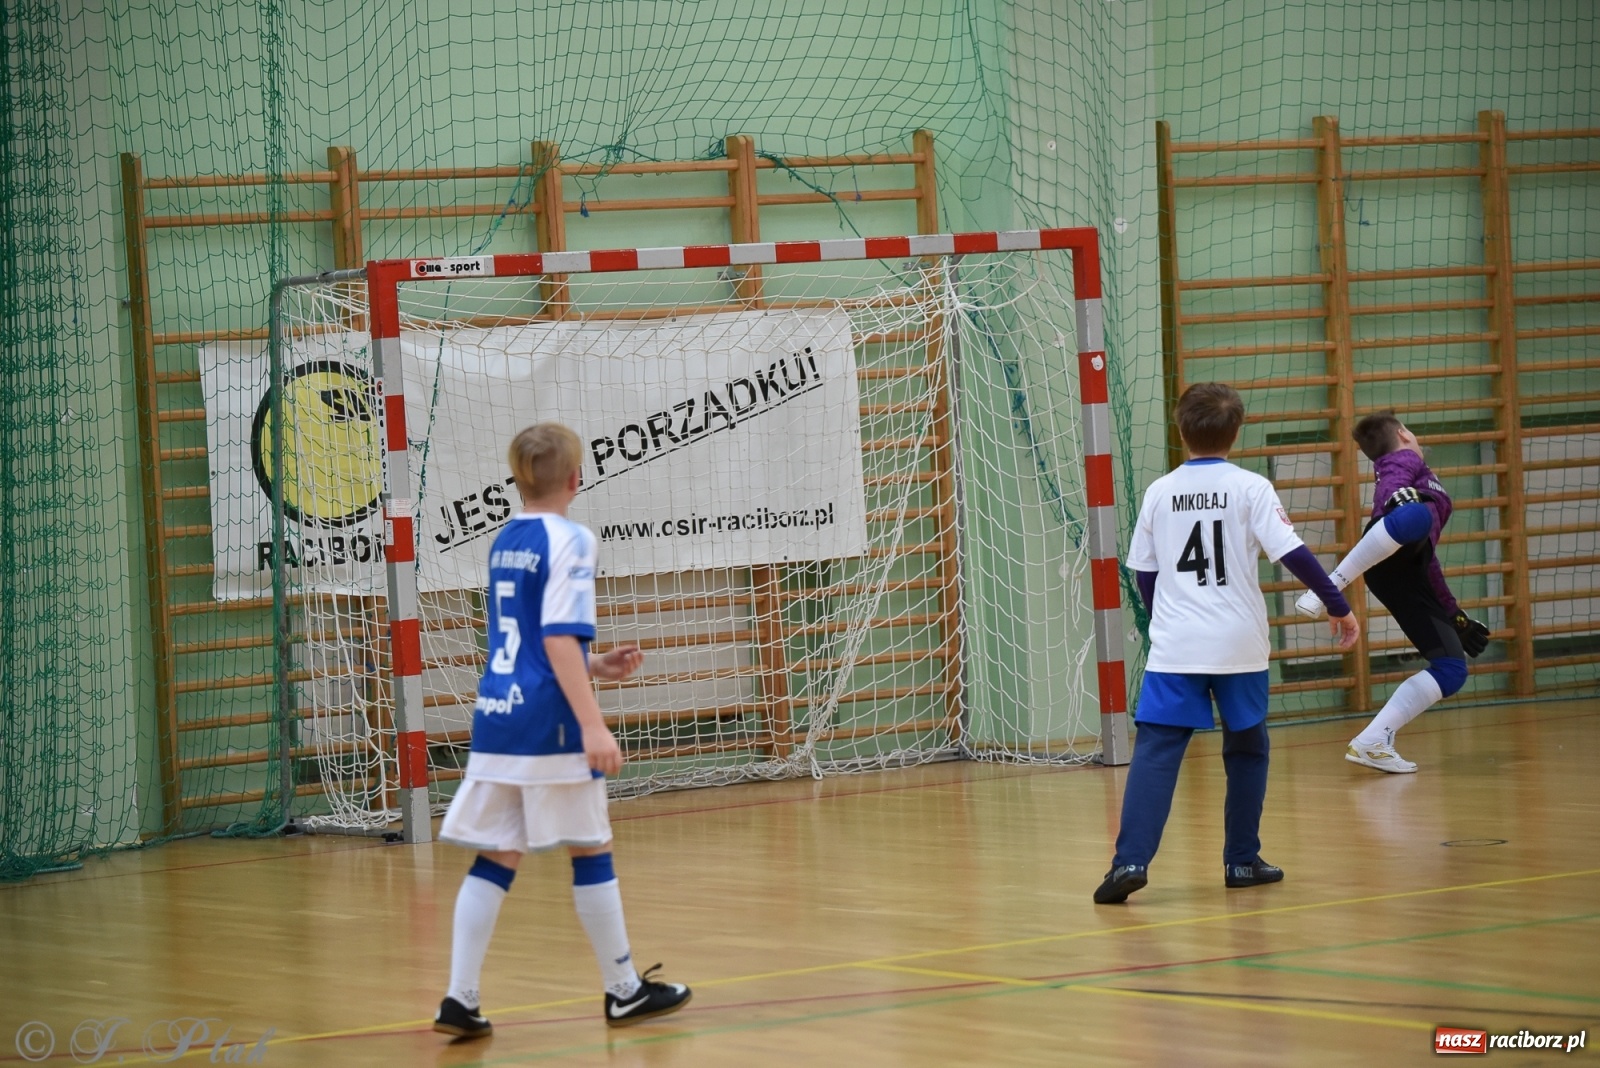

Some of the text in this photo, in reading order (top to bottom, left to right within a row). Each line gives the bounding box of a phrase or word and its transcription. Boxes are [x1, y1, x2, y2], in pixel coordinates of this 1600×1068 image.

[450, 261, 480, 274] sport
[590, 346, 821, 477] PORZĄDKU!
[600, 502, 835, 543] www.osir-raciborz.pl
[1172, 492, 1228, 512] MIKOŁAJ
[1176, 519, 1228, 587] 41
[490, 580, 522, 675] 5
